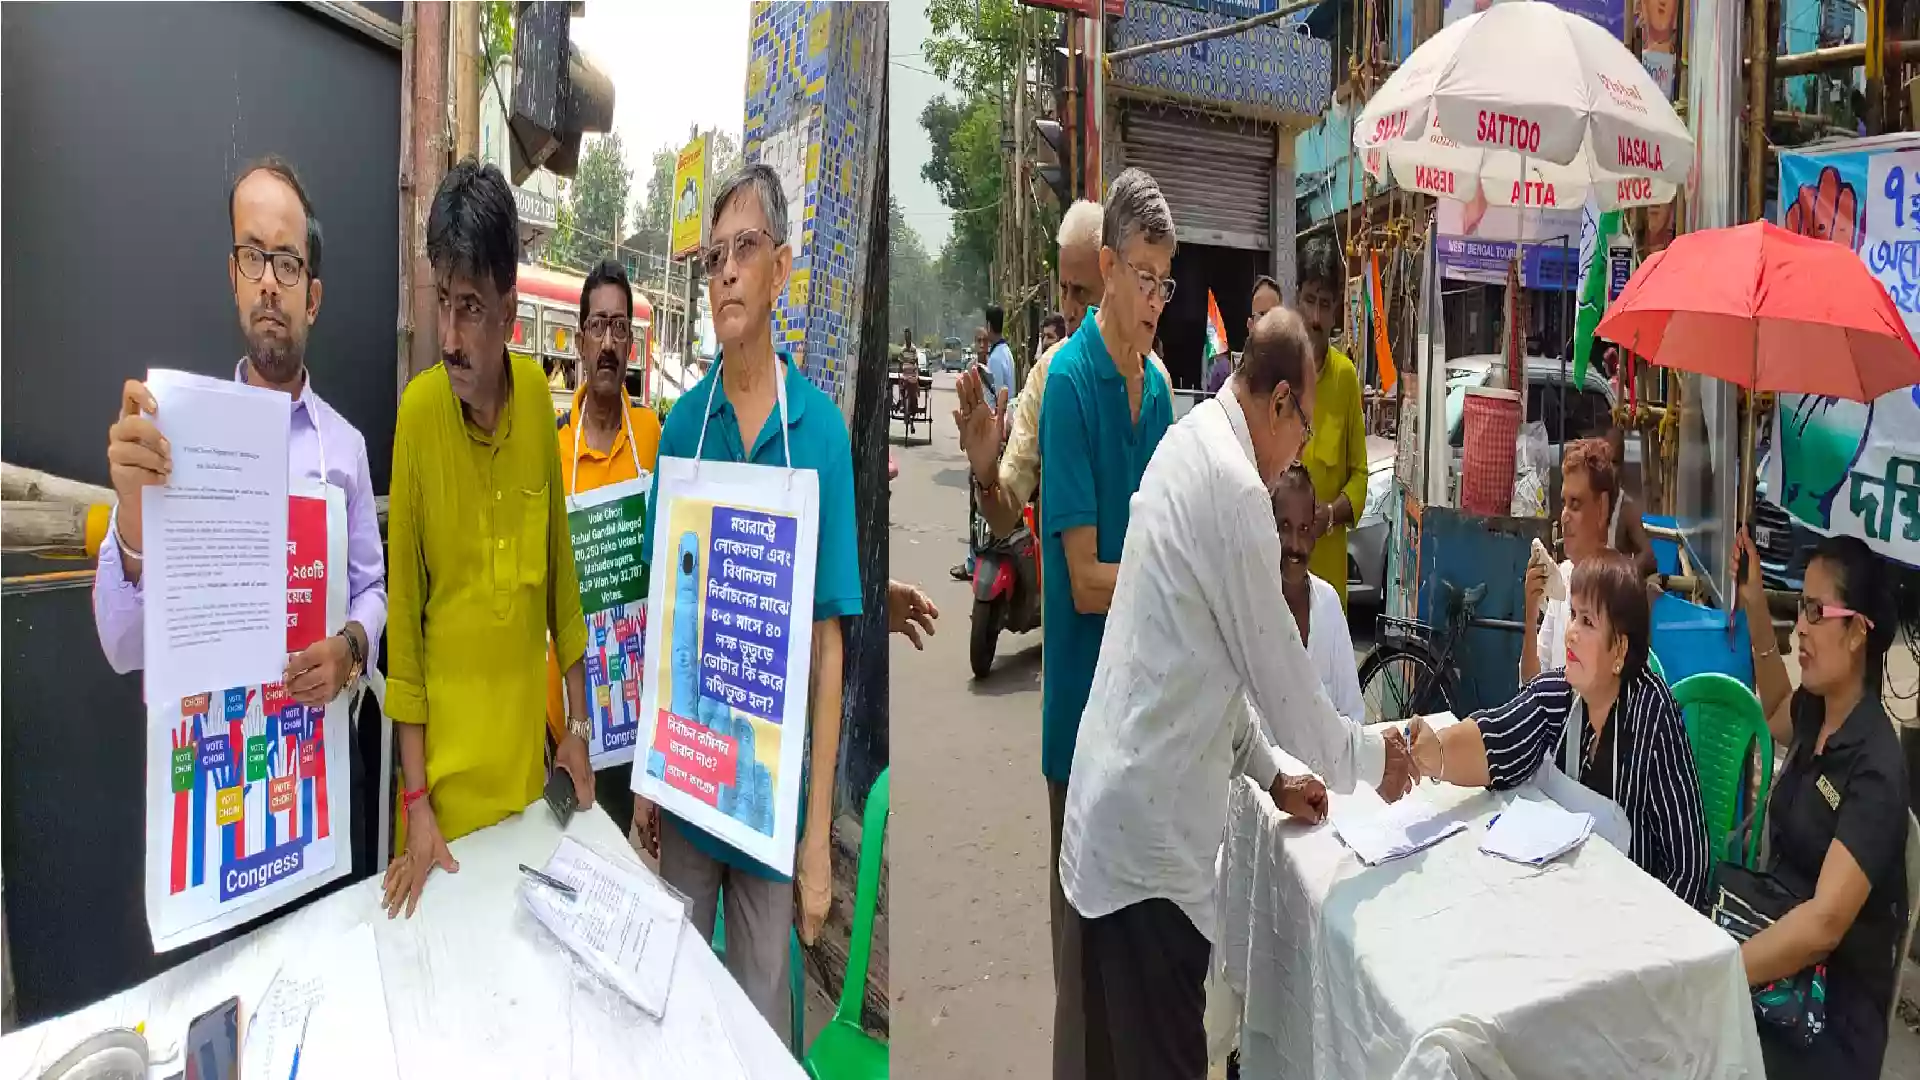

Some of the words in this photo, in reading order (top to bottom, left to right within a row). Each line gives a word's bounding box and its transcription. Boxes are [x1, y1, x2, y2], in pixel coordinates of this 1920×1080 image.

[1373, 110, 1408, 142] SUJI
[1477, 109, 1540, 153] SATTOO
[1448, 240, 1466, 253] WEST
[1467, 243, 1495, 257] BENGAL
[588, 513, 603, 525] Vote
[604, 504, 623, 518] Chori
[571, 530, 591, 547] Rahul
[592, 522, 616, 539] Gandhi
[617, 516, 642, 533] Alleged
[731, 516, 776, 543] মহারাষ্ট্রে
[600, 540, 617, 555] Fake
[618, 536, 637, 549] Votes
[714, 538, 765, 560] লোকসভা
[767, 548, 791, 567] এবং
[580, 580, 593, 593] BJP
[594, 576, 609, 589] Won
[609, 572, 619, 586] by
[723, 558, 777, 588] বিধানসভা
[708, 578, 758, 609] নির্বাচনের
[760, 595, 790, 615] মাঝে
[736, 614, 764, 635] মাসে
[765, 622, 781, 638] ৪০
[715, 632, 737, 651] লক্ষ
[703, 652, 739, 676] ভোটার
[742, 660, 757, 681] কি
[758, 670, 785, 692] করে
[705, 675, 747, 705] নথিভুক্ত
[748, 691, 774, 713] হল?
[175, 752, 191, 764] VOTE
[206, 740, 224, 752] VOTE
[226, 852, 299, 892] Congress
